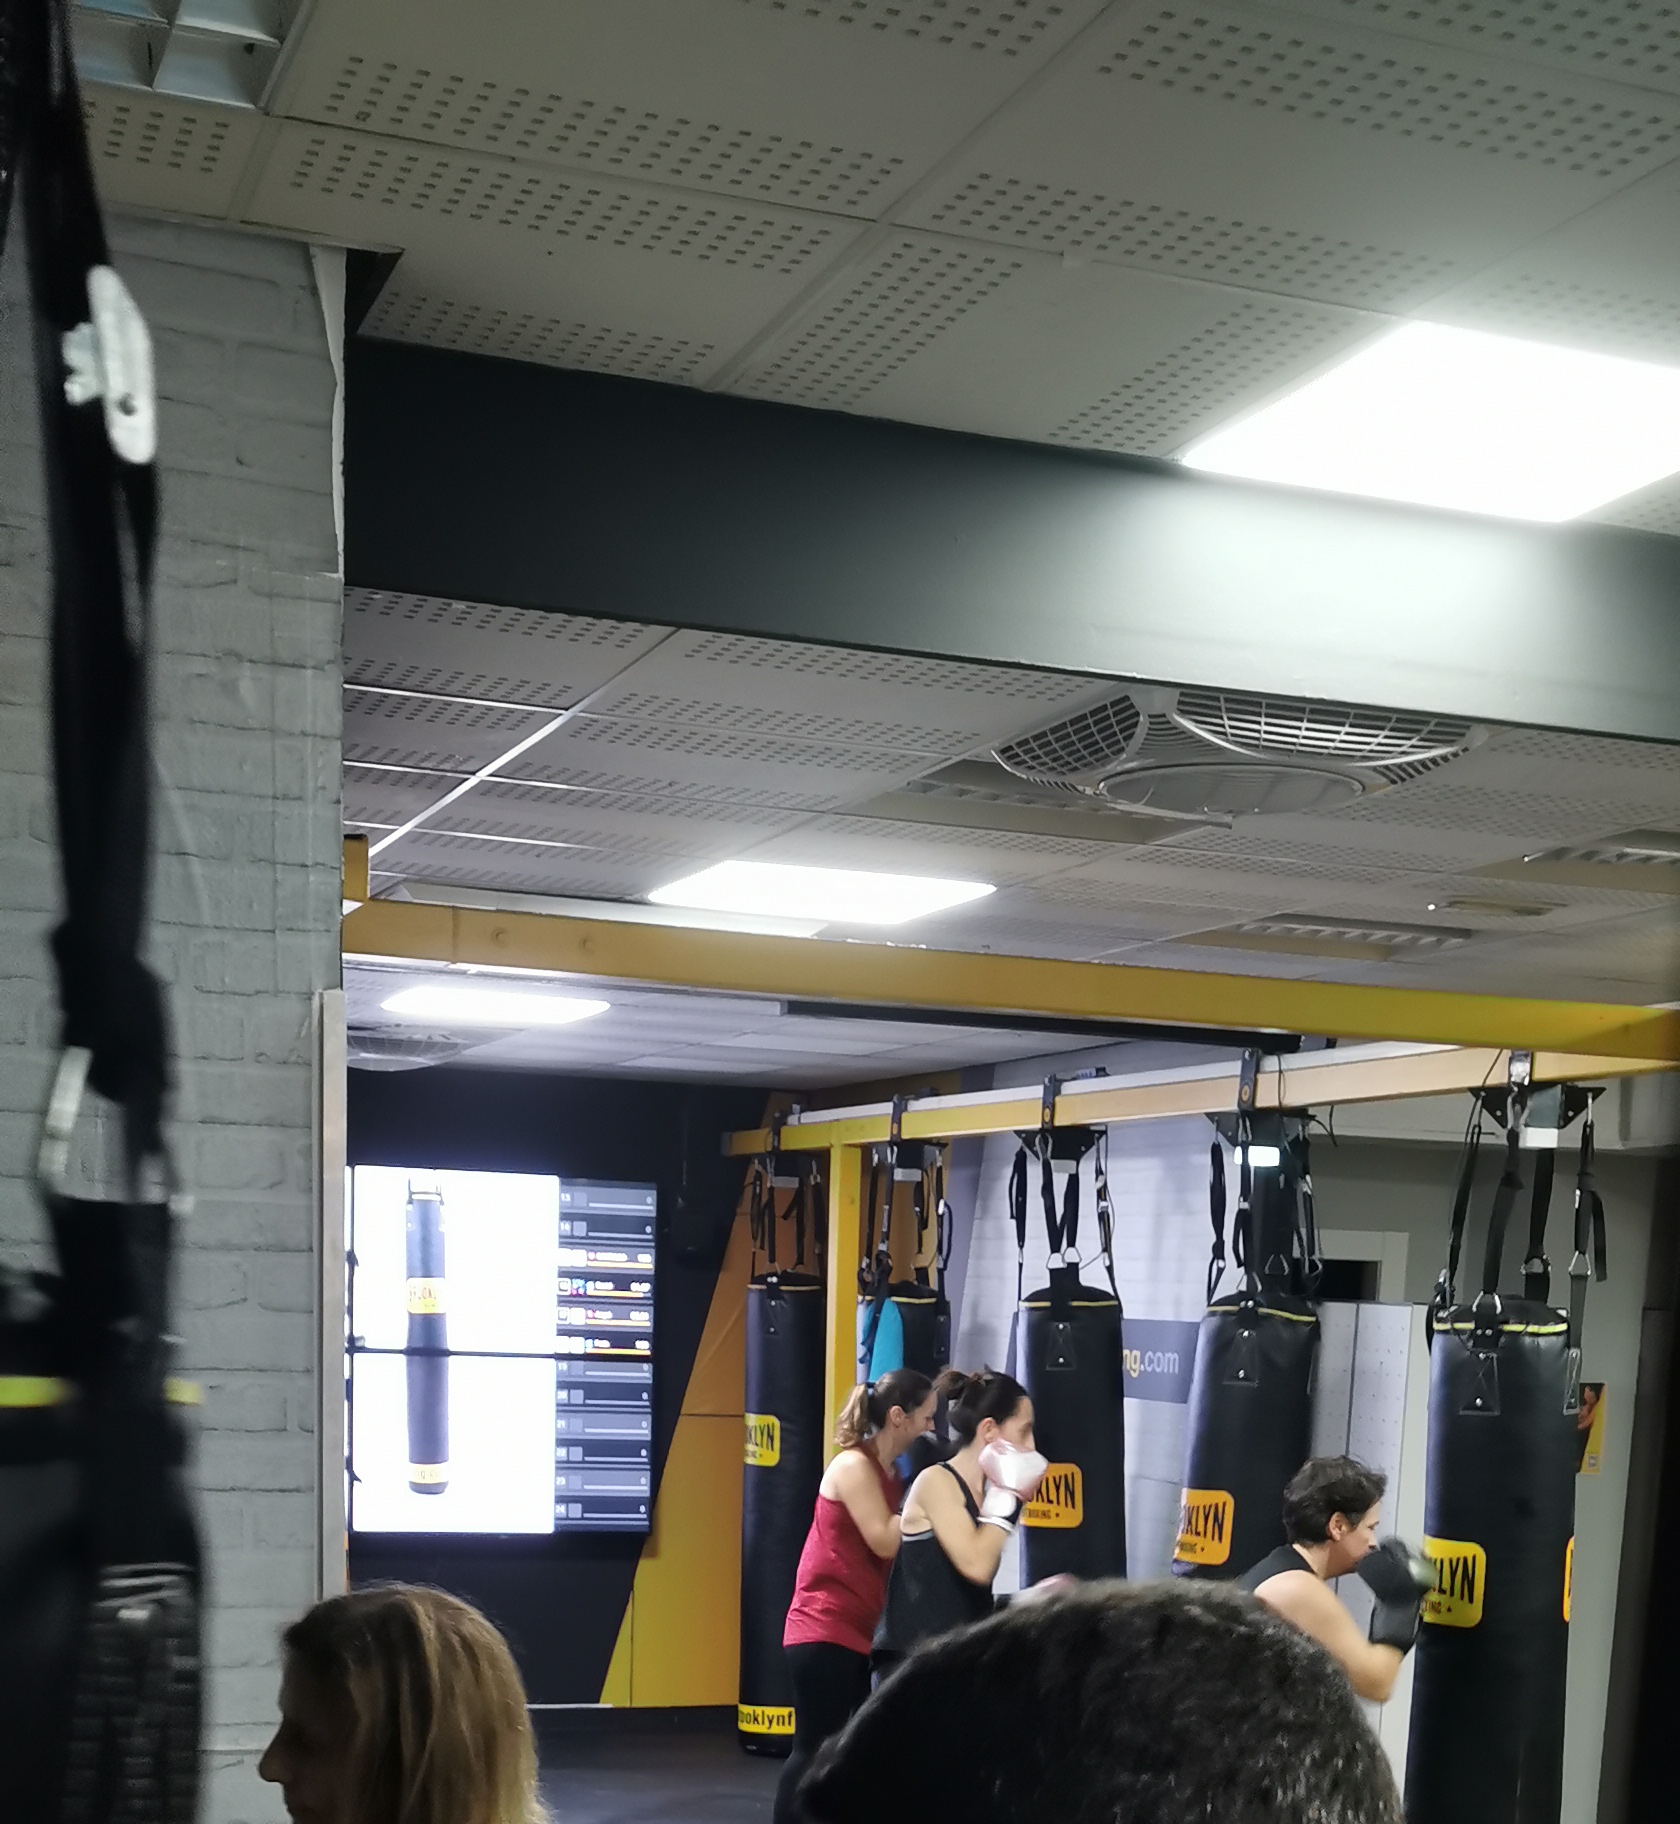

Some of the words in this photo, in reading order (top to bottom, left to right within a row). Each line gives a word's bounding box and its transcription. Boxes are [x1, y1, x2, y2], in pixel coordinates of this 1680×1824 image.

[746, 1422, 775, 1452] KLYN
[1028, 1472, 1076, 1510] KLYN
[1182, 1501, 1227, 1544] KLYN
[1432, 1554, 1476, 1604] LYN
